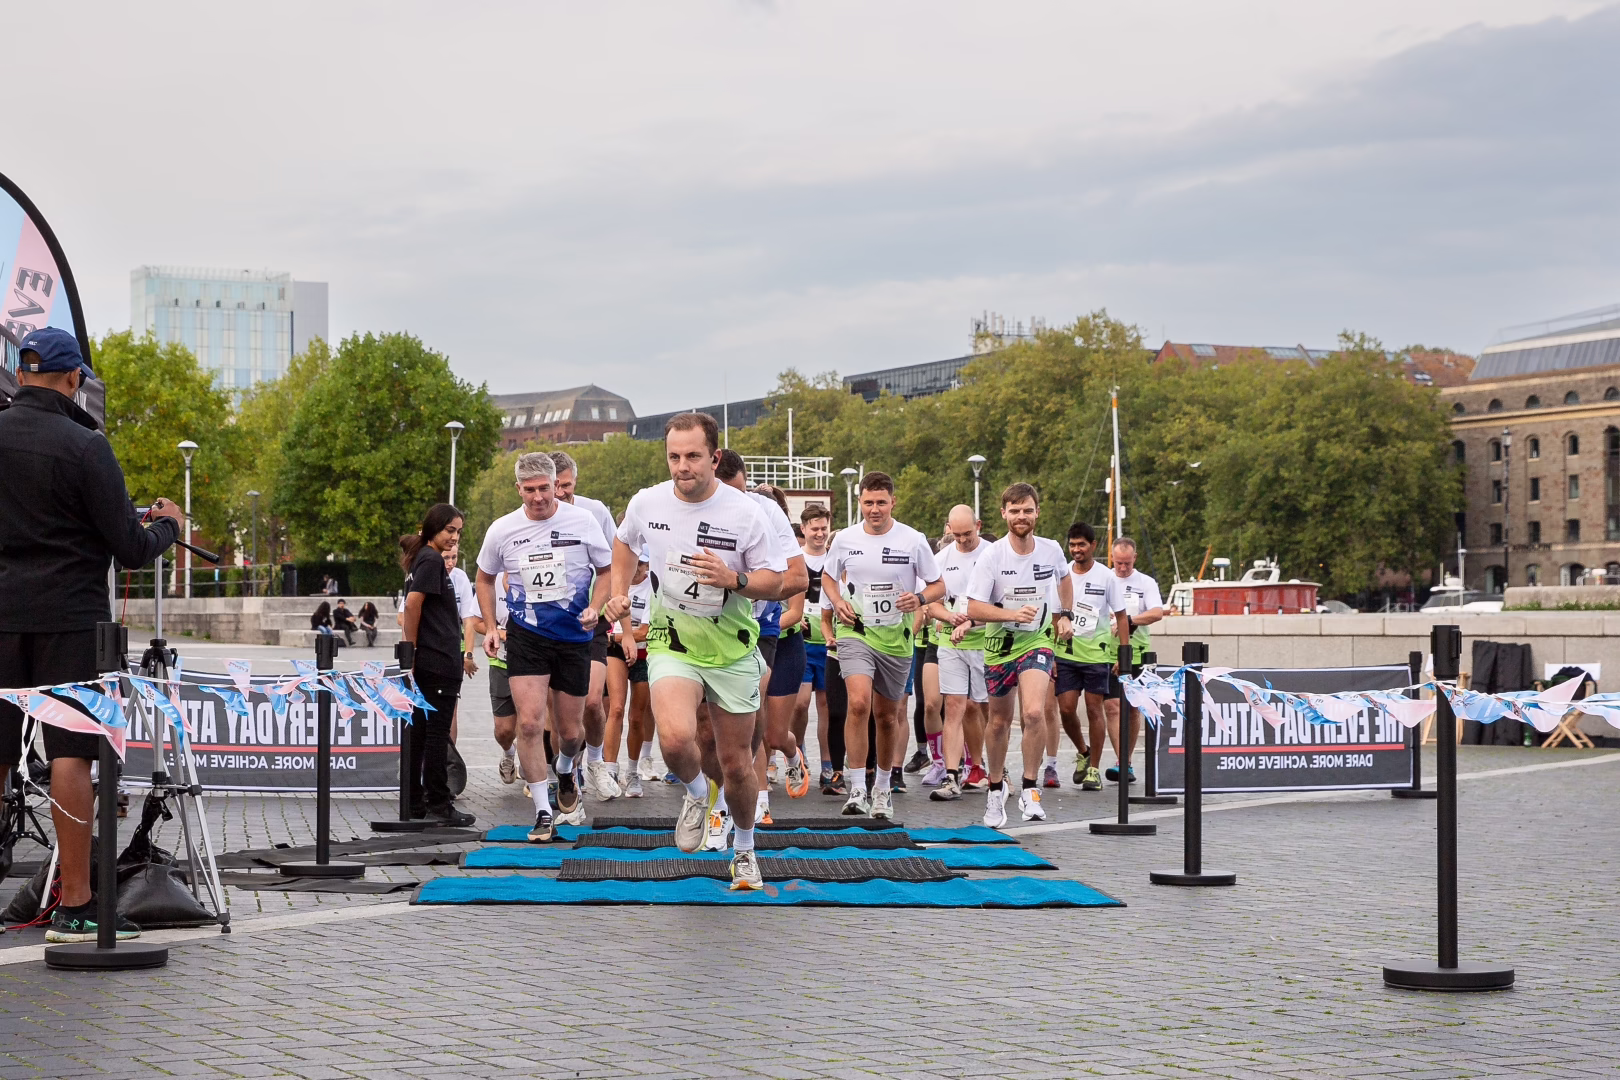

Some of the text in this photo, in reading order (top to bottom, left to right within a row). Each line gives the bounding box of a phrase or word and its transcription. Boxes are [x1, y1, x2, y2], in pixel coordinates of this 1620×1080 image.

[648, 521, 671, 531] ruun.
[532, 571, 556, 588] 42
[684, 581, 700, 600] 4
[872, 599, 892, 614] 10
[1074, 615, 1087, 627] 18
